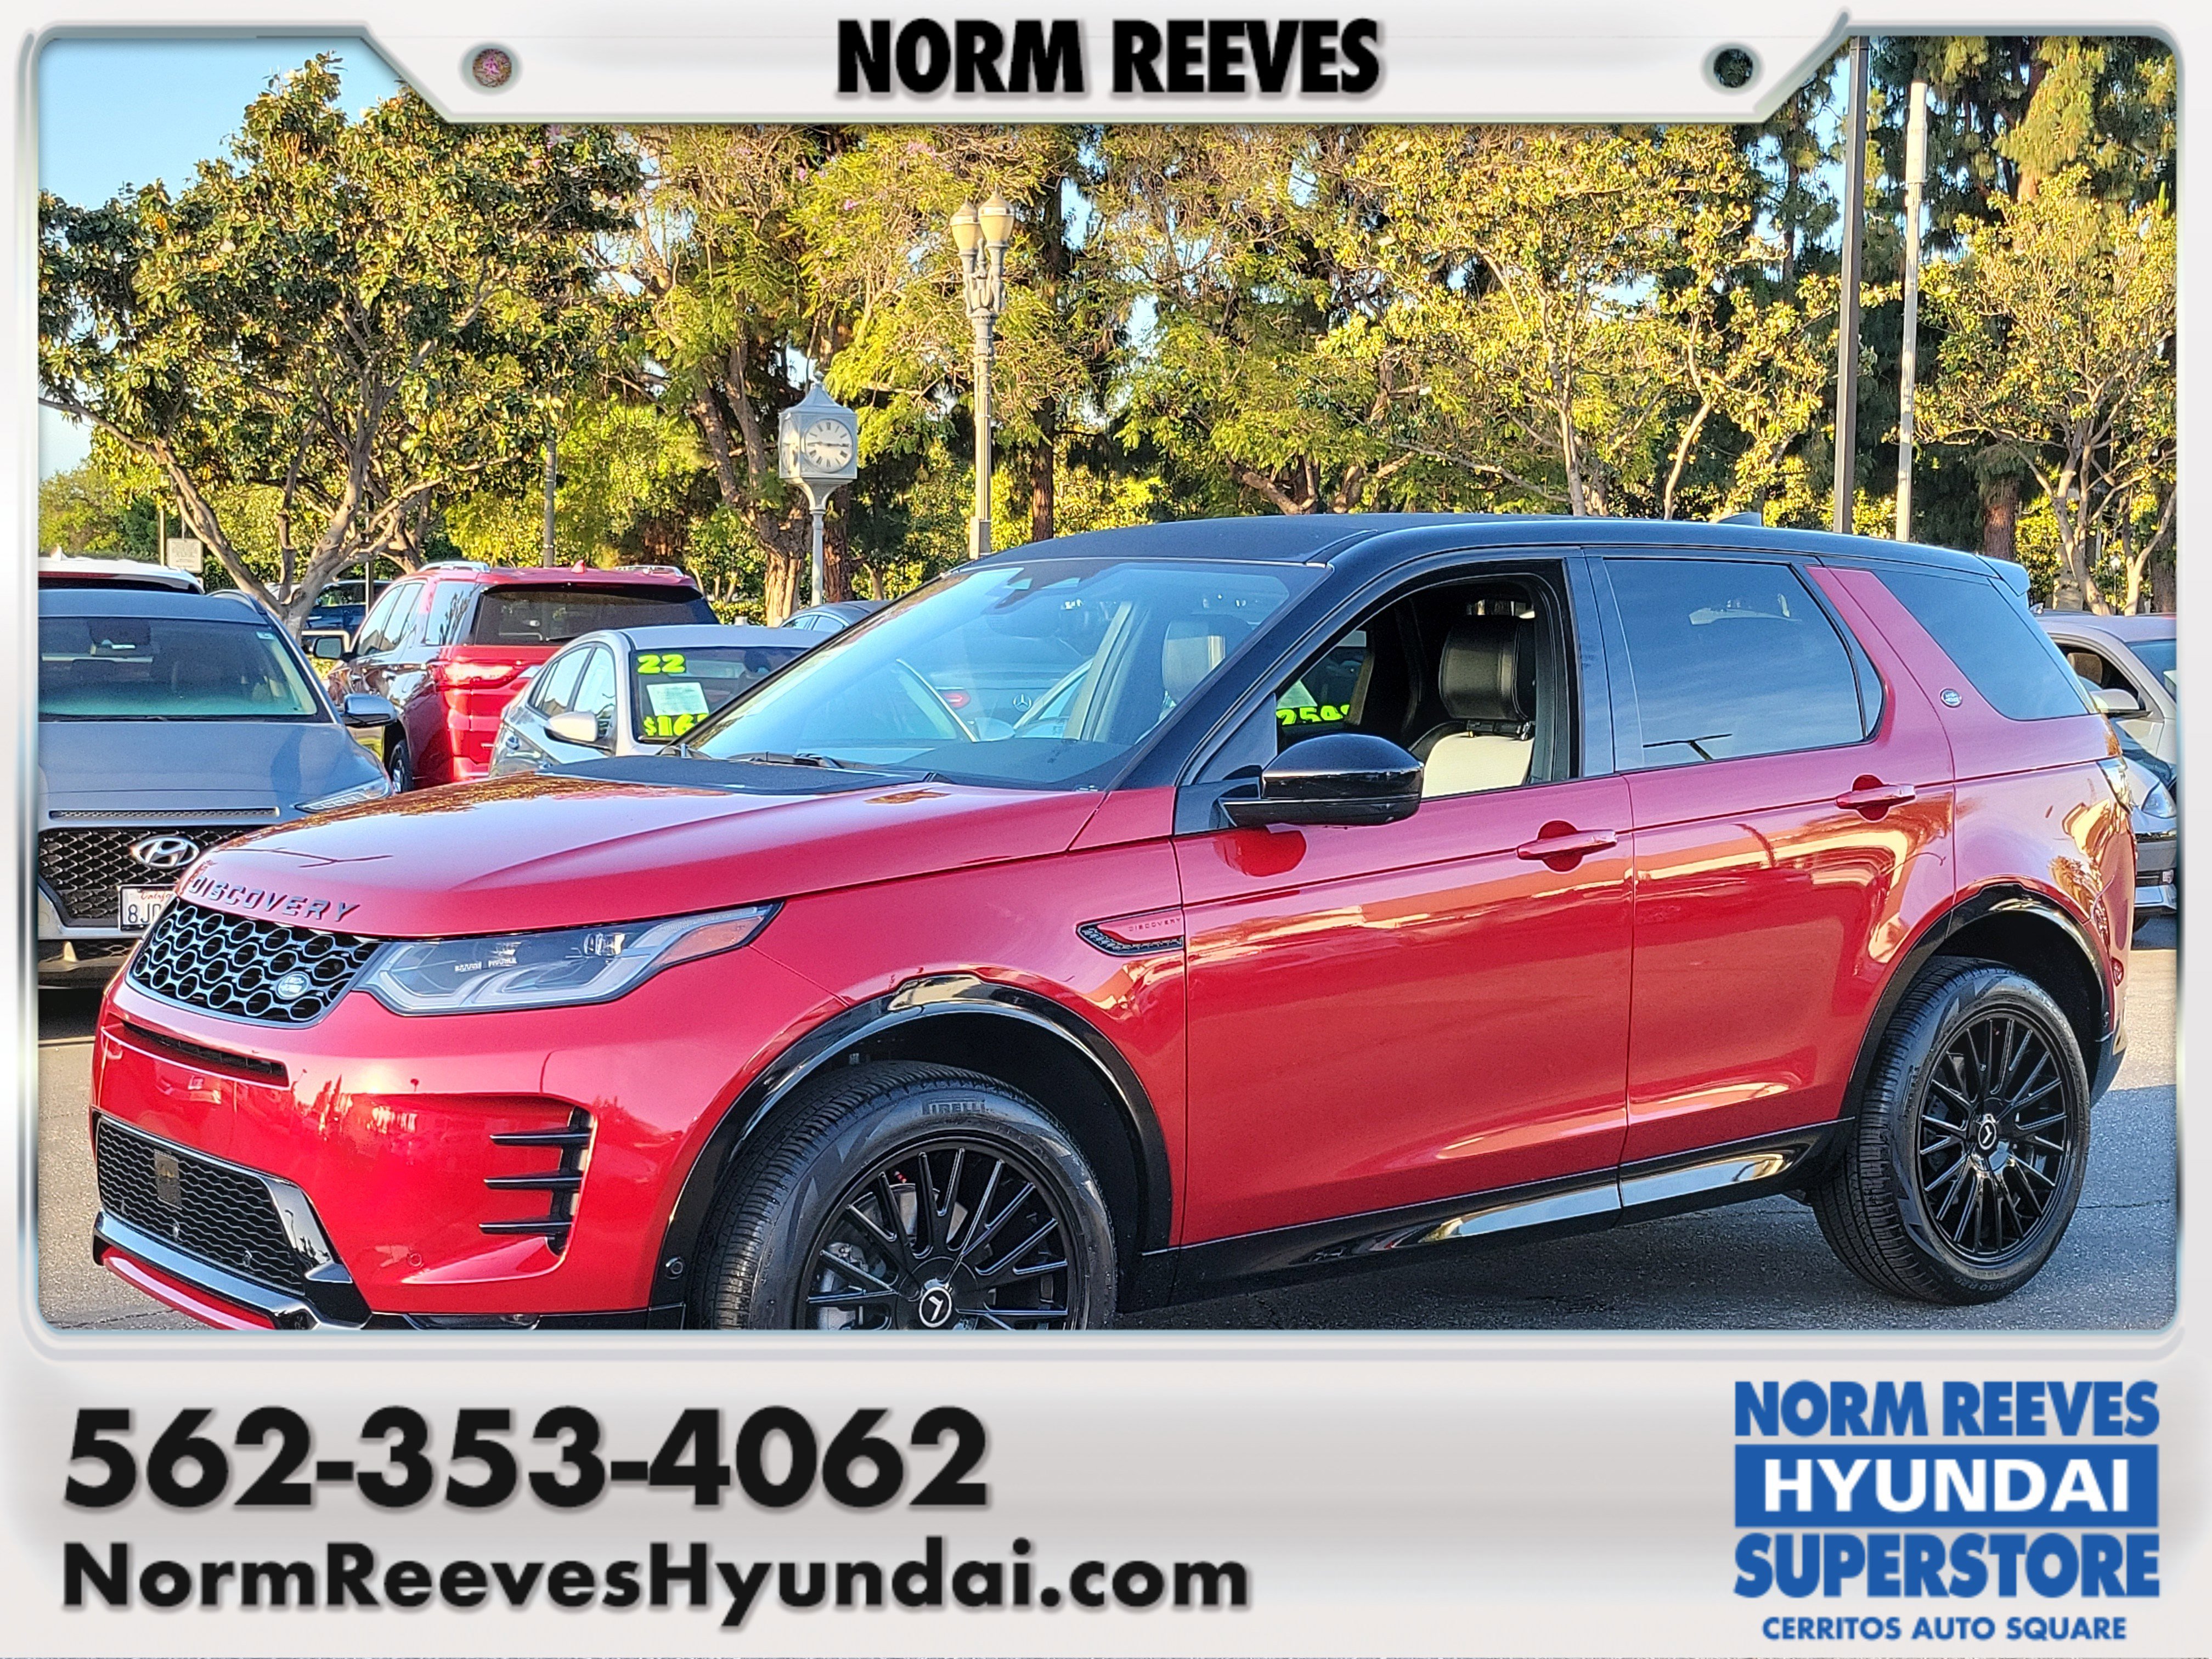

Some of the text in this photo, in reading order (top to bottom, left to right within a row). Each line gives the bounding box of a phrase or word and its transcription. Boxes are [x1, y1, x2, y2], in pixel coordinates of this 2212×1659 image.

[637, 654, 686, 674] 22
[189, 875, 360, 922] DISCOVERY
[1128, 917, 1181, 932] DISCOVERY
